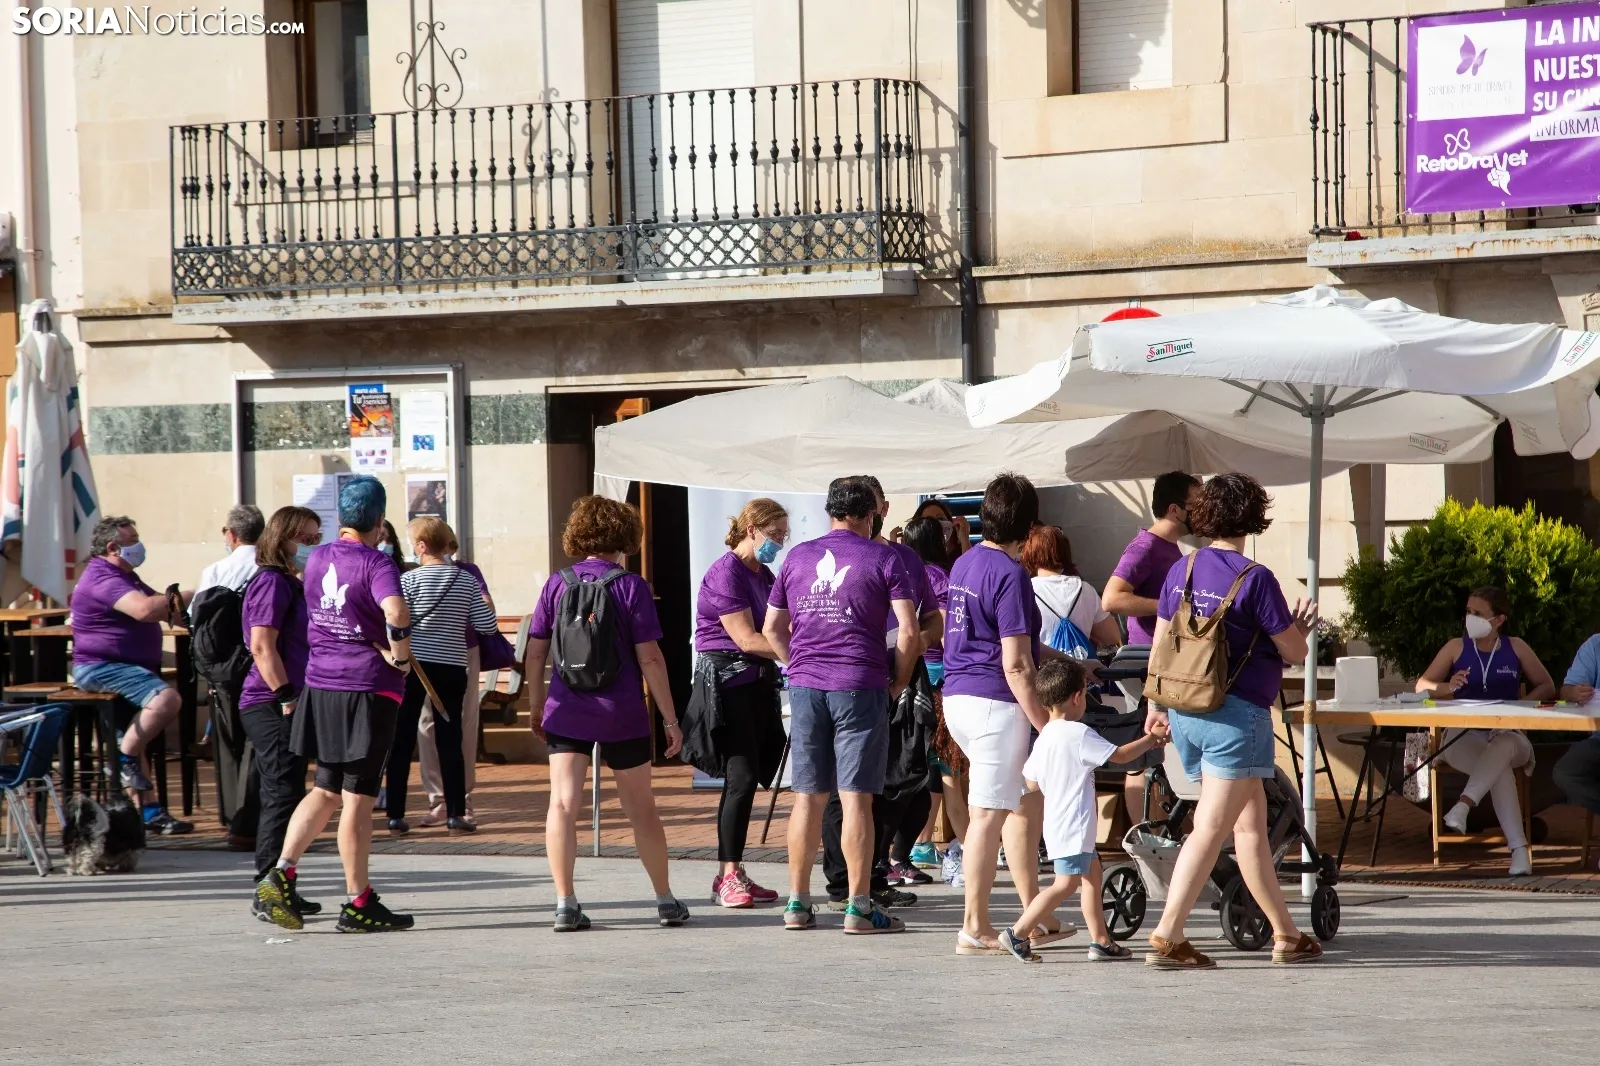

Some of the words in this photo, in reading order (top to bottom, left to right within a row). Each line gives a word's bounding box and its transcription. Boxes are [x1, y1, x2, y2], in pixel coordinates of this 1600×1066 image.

[1534, 19, 1566, 46] LA
[1572, 16, 1600, 43] IN
[1532, 91, 1558, 112] SU
